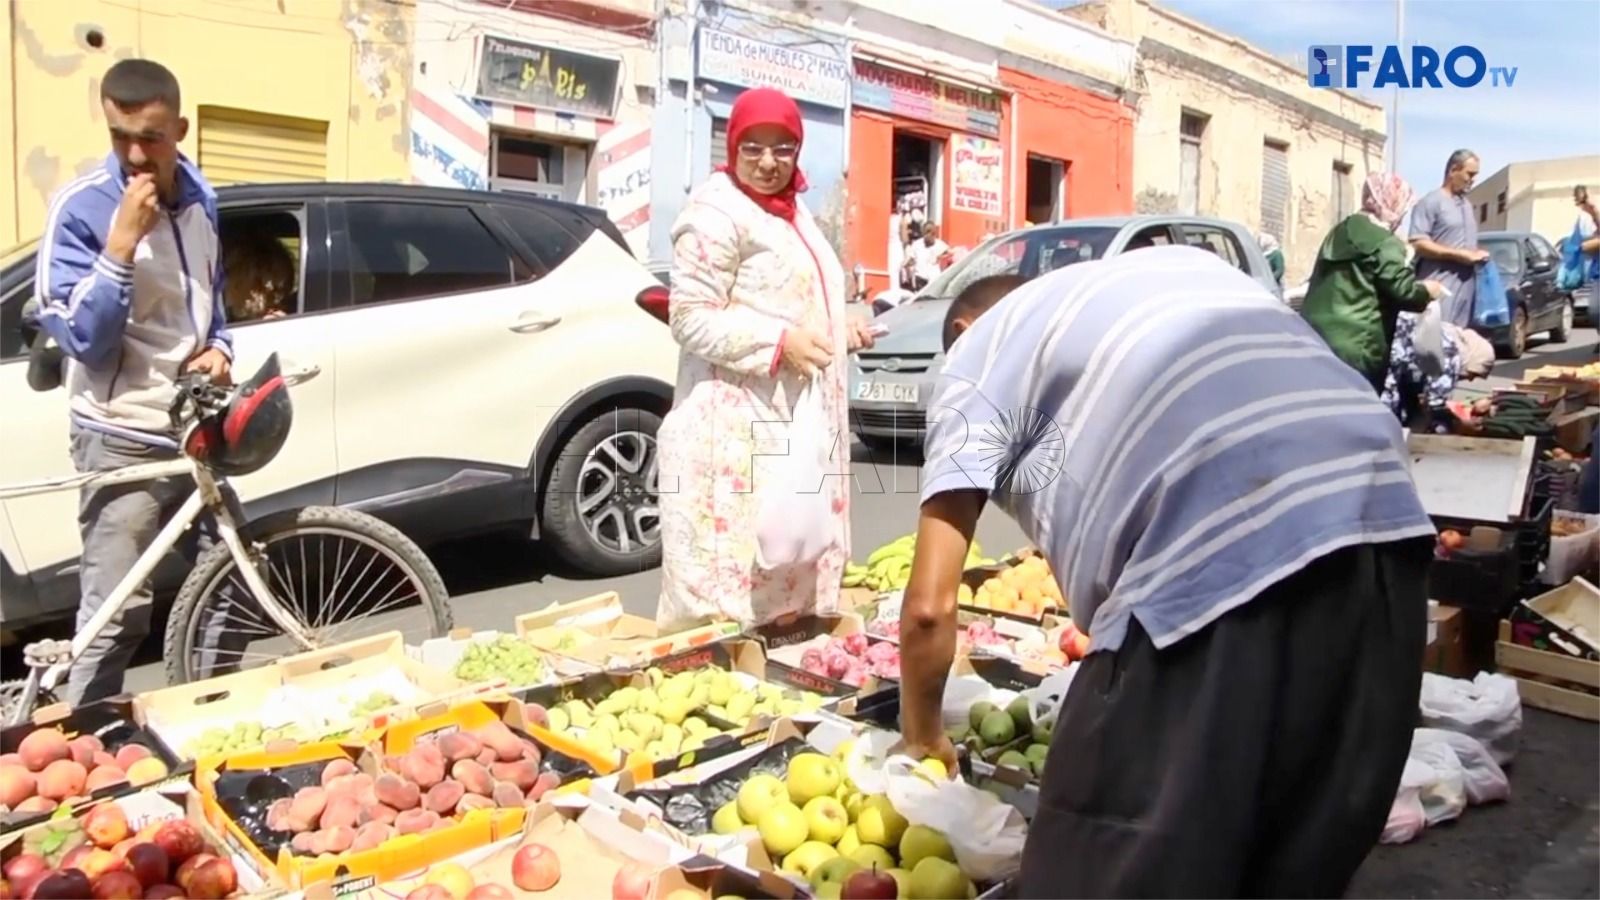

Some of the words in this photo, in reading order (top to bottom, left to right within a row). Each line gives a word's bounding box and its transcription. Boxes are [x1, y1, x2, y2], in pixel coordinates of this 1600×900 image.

[704, 30, 742, 55] TIENDA
[743, 42, 757, 60] de
[758, 44, 805, 73] MUEBLES
[818, 60, 846, 82] MANO
[741, 67, 806, 91] SUHAILA
[853, 60, 941, 101] NOVEDADES
[943, 83, 1001, 114] MELILLA
[893, 384, 915, 401] CYK
